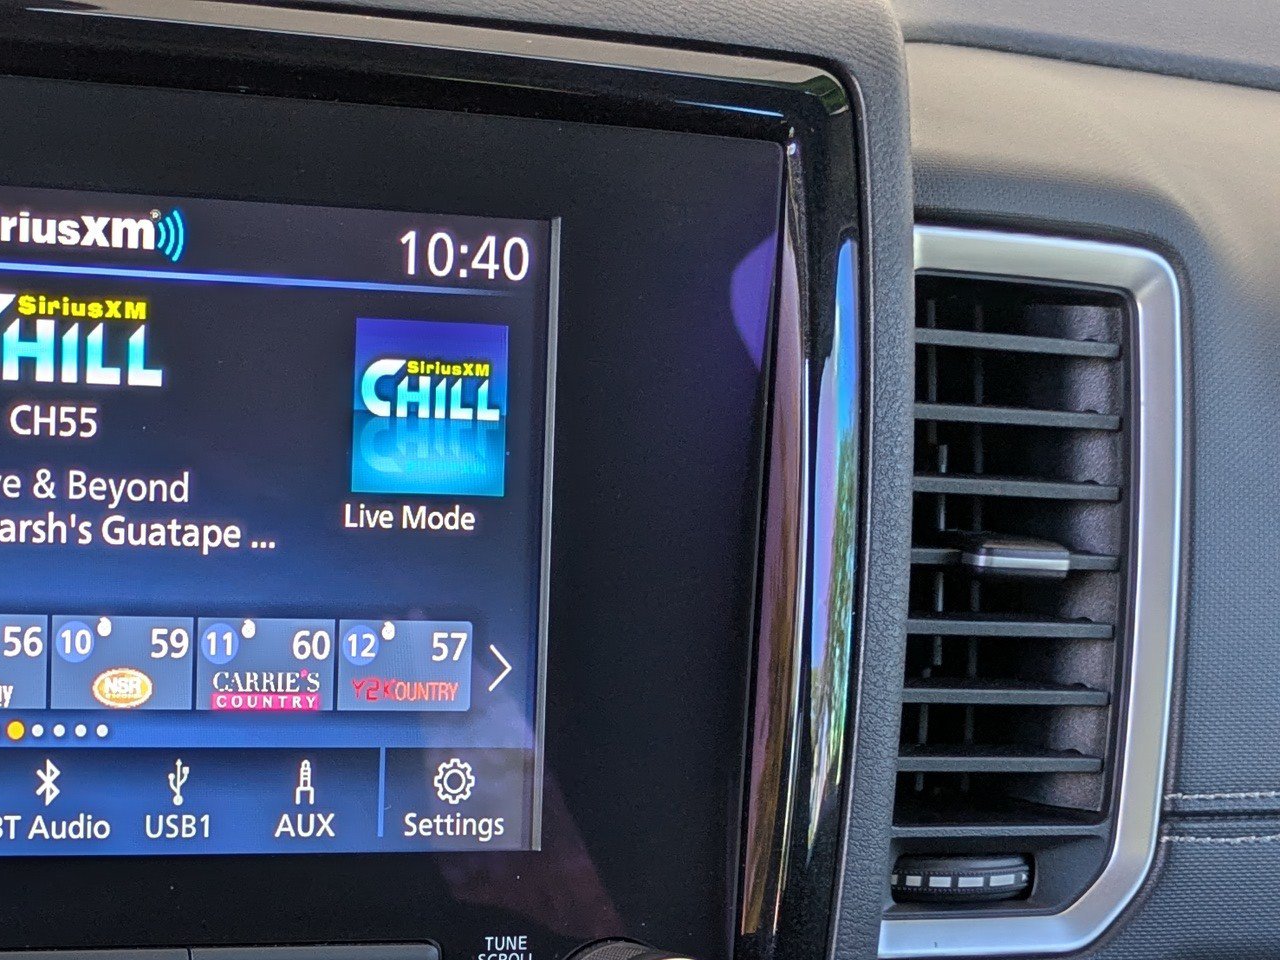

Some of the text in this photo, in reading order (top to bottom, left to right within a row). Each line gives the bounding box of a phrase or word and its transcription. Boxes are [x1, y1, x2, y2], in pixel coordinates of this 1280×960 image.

[400, 230, 529, 281] 10:40
[18, 295, 147, 320] SiriusXM
[407, 360, 490, 377] SiriusXM
[361, 359, 500, 421] CHILL
[9, 404, 98, 438] CH55
[32, 468, 57, 500] &
[67, 471, 190, 507] Beyond
[344, 503, 476, 531] Live Mode
[101, 514, 242, 555] Guatape
[3, 625, 43, 657] 56
[61, 629, 91, 655] 10
[150, 628, 189, 659] 59
[207, 631, 233, 656] 11
[292, 630, 331, 660] 60
[347, 633, 376, 658] 12
[431, 632, 468, 661] 57
[216, 695, 317, 709] COUNTRY
[29, 814, 111, 840] Audio
[144, 814, 211, 838] USB1
[274, 813, 336, 838] AUX
[403, 811, 505, 842] Settings
[485, 935, 528, 951] TUNE
